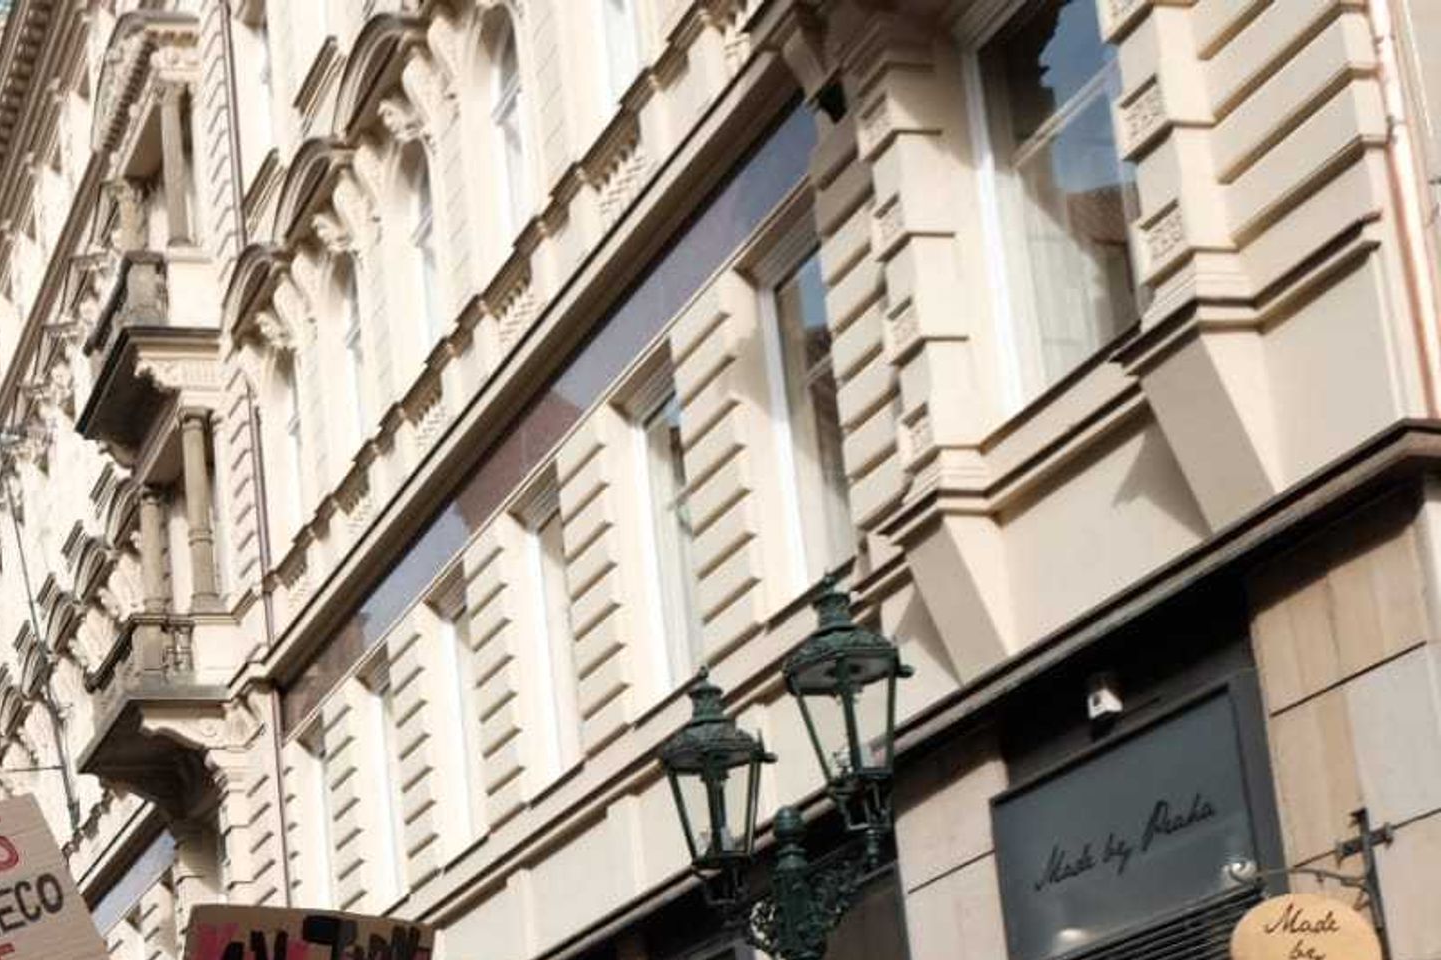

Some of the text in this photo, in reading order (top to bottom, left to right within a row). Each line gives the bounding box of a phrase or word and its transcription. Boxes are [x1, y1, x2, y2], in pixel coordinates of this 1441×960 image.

[1034, 792, 1215, 891] Made by Praha
[1264, 902, 1340, 934] Made
